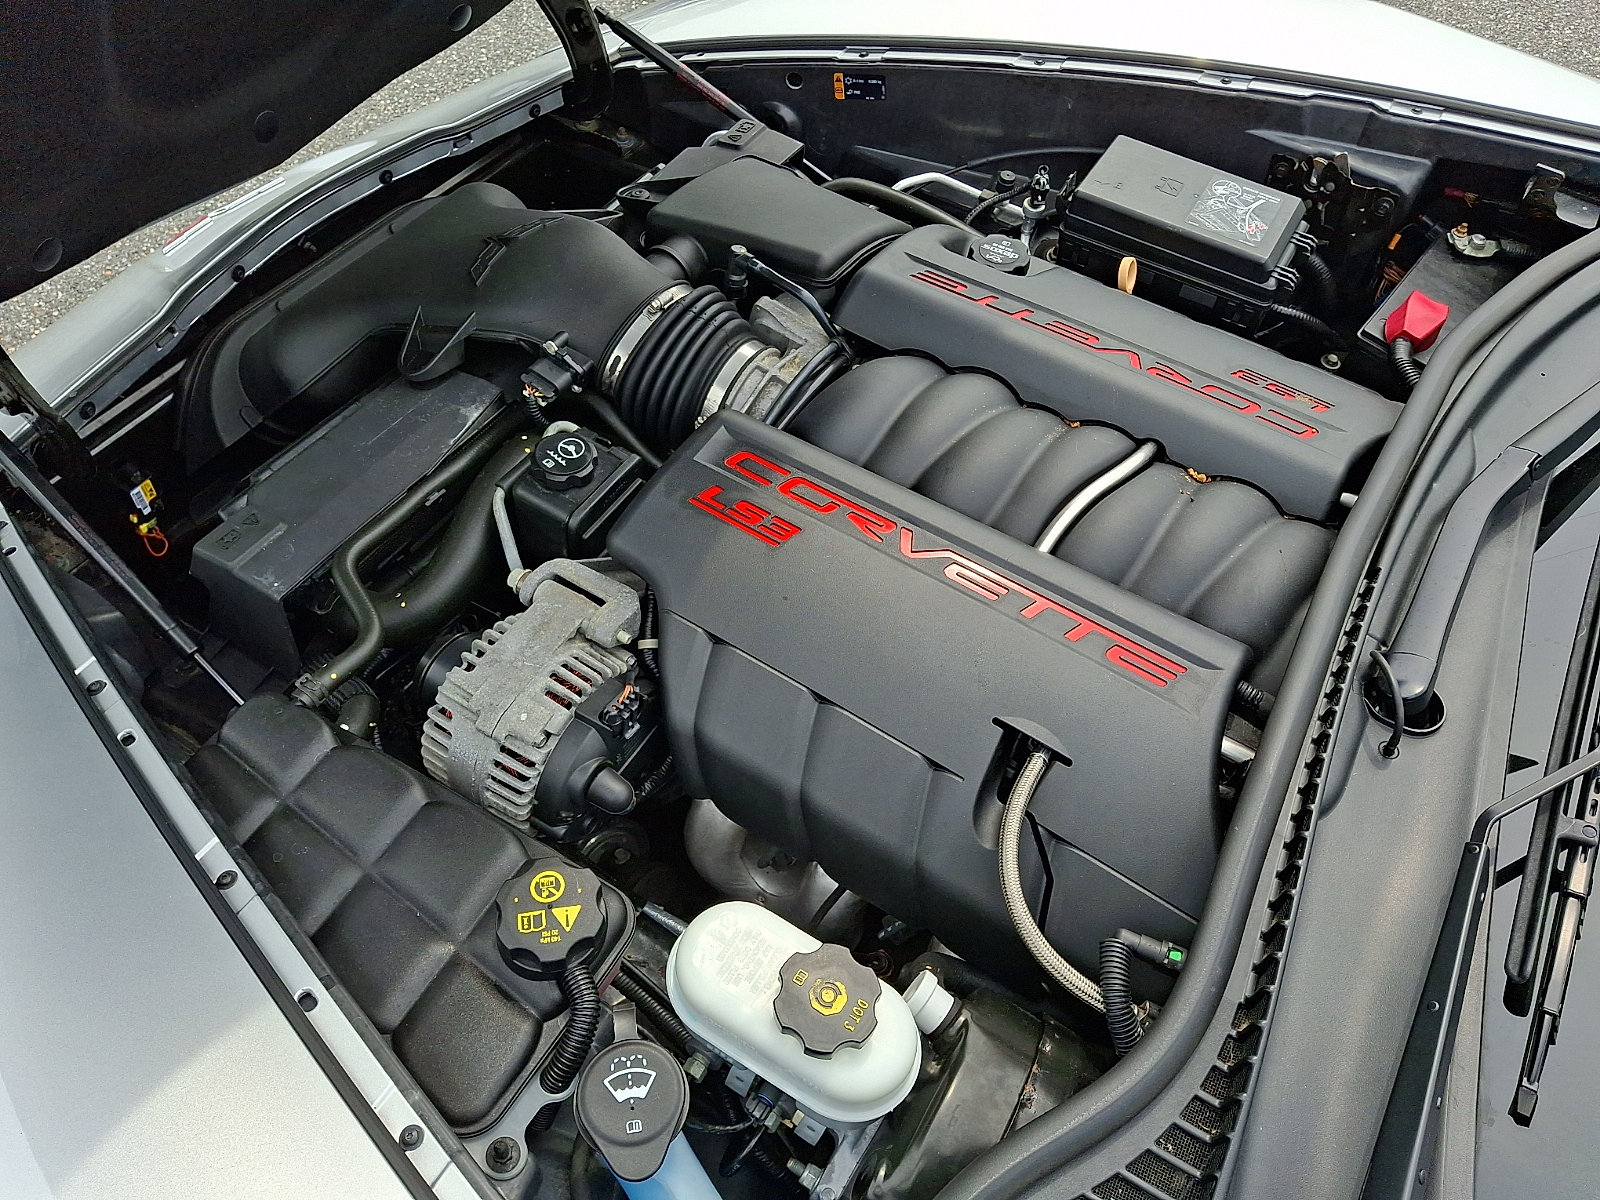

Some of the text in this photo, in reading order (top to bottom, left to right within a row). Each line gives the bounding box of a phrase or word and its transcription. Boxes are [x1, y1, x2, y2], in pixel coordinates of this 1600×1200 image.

[980, 243, 1019, 259] dexos
[909, 269, 1320, 439] CORVETTE
[1231, 368, 1336, 413] LS3
[688, 484, 803, 547] LS3
[724, 450, 1189, 688] CORVETTE
[843, 998, 869, 1032] DOT 3
